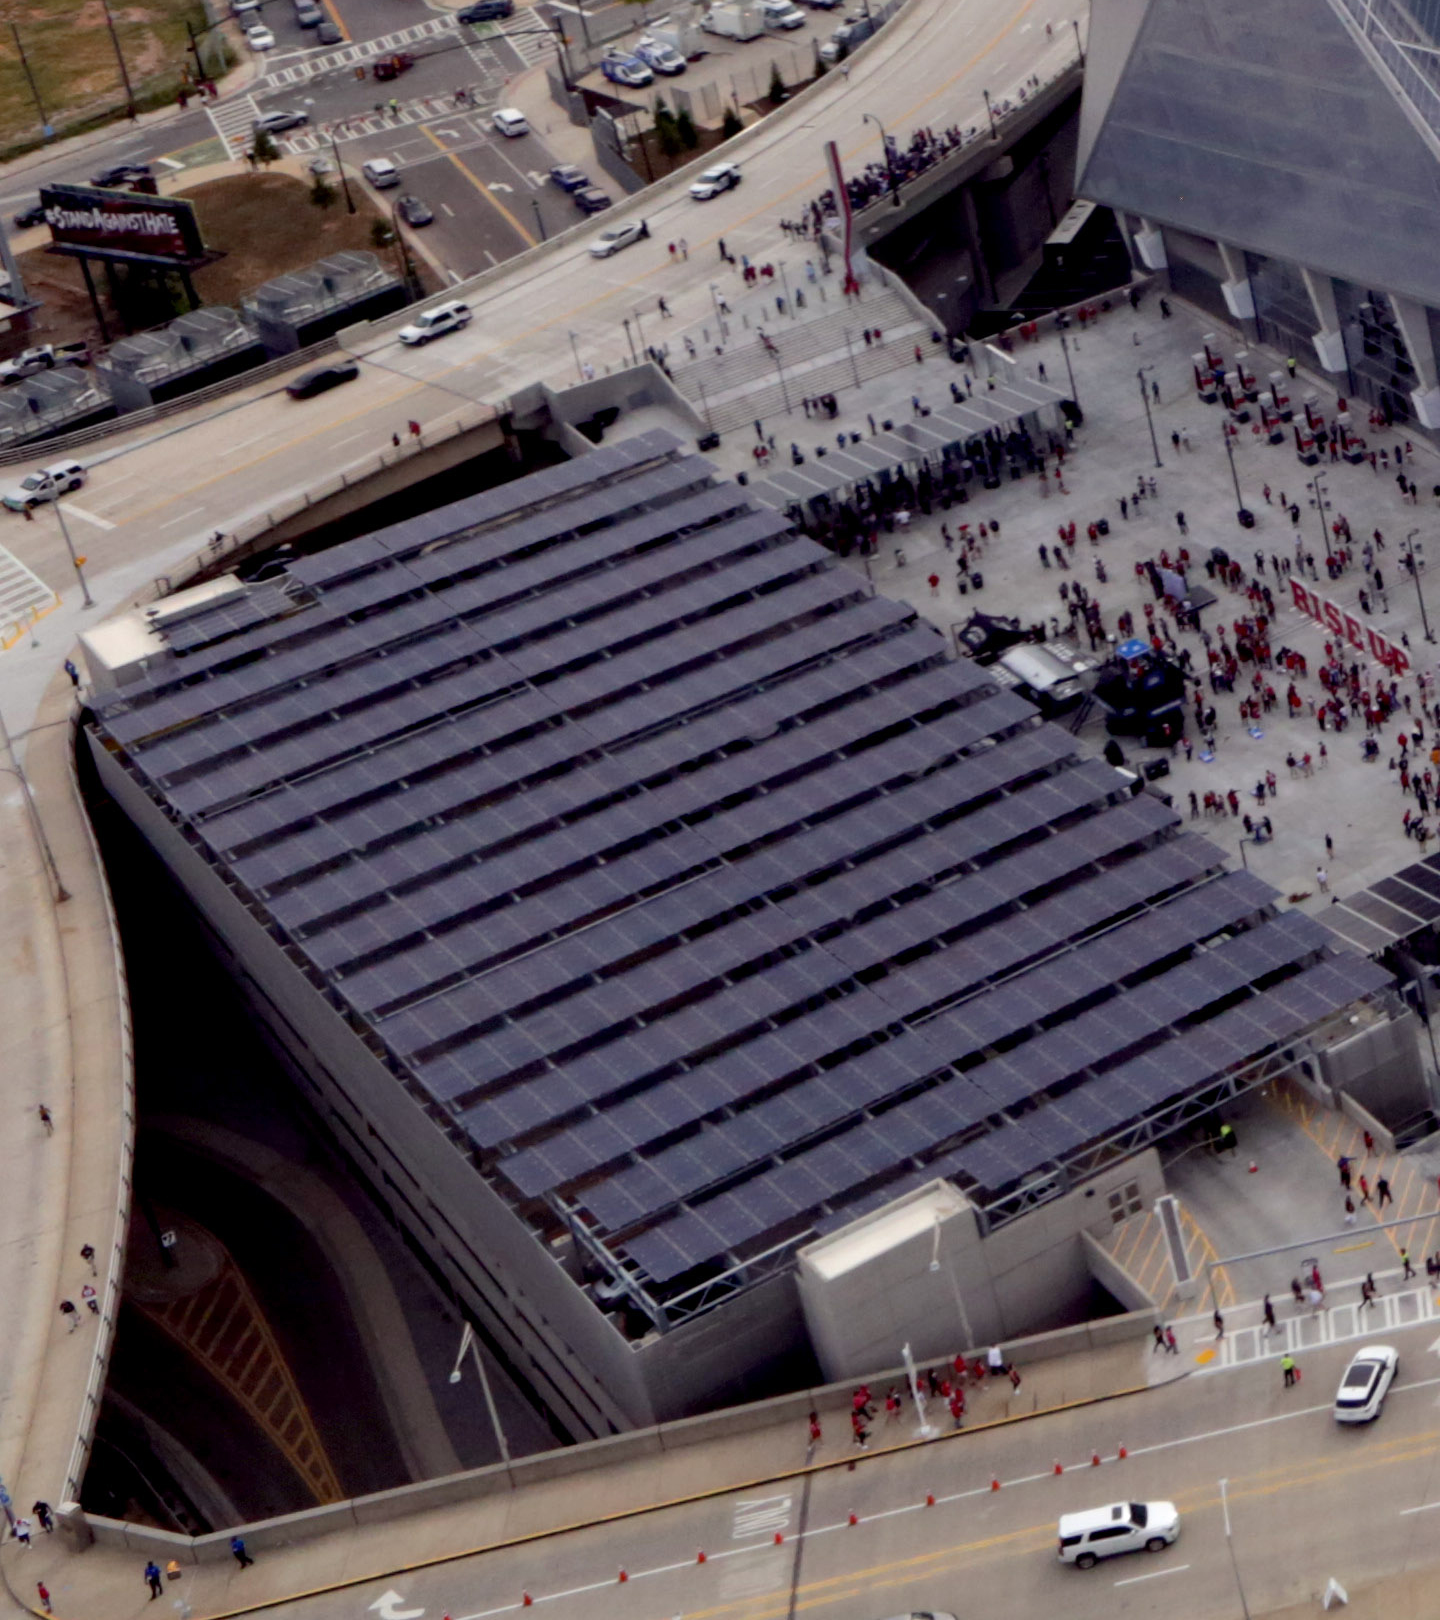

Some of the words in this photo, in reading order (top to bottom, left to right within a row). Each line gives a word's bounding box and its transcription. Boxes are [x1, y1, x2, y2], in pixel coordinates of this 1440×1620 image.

[1288, 577, 1366, 653] RISE
[1366, 626, 1411, 678] UP
[732, 1493, 792, 1539] ONLY
